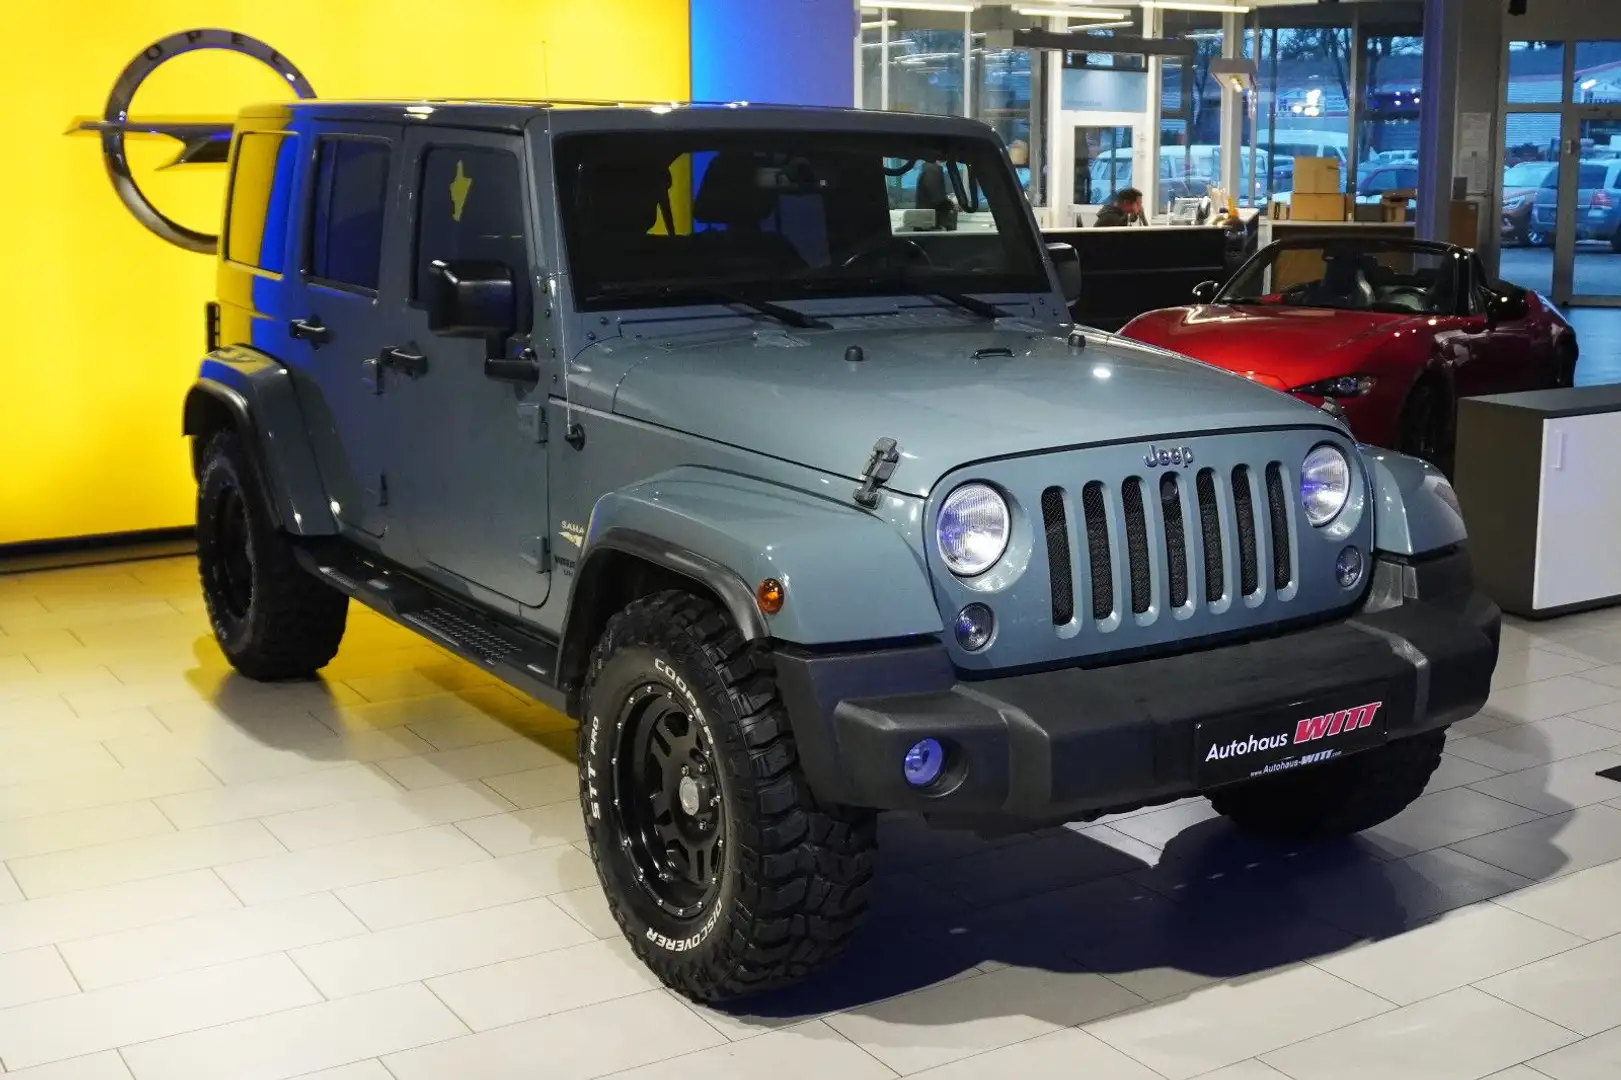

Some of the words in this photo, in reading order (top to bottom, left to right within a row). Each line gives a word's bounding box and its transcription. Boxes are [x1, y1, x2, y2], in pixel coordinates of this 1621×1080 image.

[143, 30, 283, 66] OPEL
[1143, 444, 1194, 468] Jeep
[654, 657, 714, 745] COOPER
[1205, 733, 1289, 762] Autohaus
[1293, 701, 1383, 744] WITT
[646, 896, 722, 952] DISCOVERER
